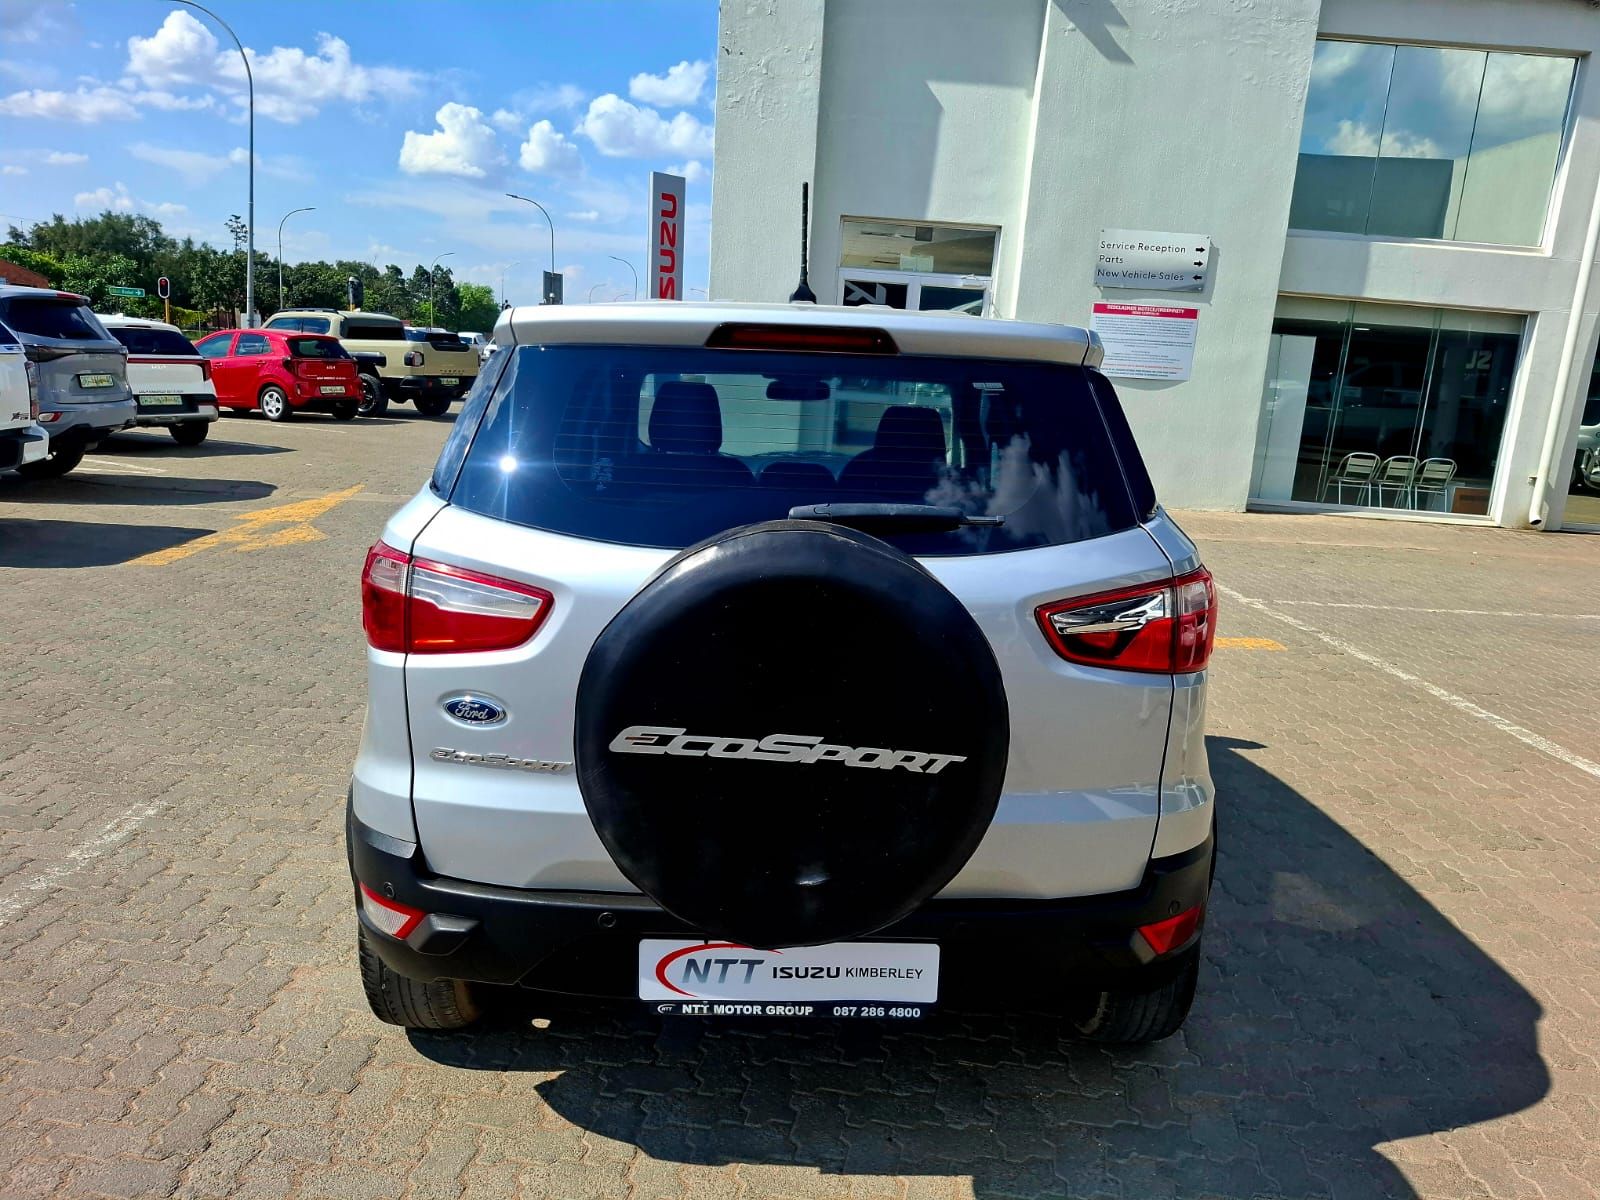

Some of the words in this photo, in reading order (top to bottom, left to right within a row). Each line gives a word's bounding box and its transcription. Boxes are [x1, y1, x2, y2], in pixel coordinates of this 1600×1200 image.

[1100, 241, 1135, 251] Service
[1137, 242, 1186, 254] Reception
[1099, 254, 1124, 264] Parts
[1097, 268, 1119, 278] New
[1121, 270, 1157, 280] Vehicle
[1159, 271, 1184, 281] Sales
[454, 700, 489, 720] Ford
[609, 725, 968, 774] ECOSPORT
[682, 958, 765, 984] NTT
[772, 966, 840, 979] ISUZU
[845, 967, 923, 979] KIMBERLEY
[682, 1004, 710, 1014] NTT
[713, 1005, 762, 1015] MOTOR
[765, 1005, 813, 1016] GROUP
[833, 1006, 857, 1017] 087
[861, 1006, 885, 1017] 286
[888, 1007, 921, 1018] 4800
